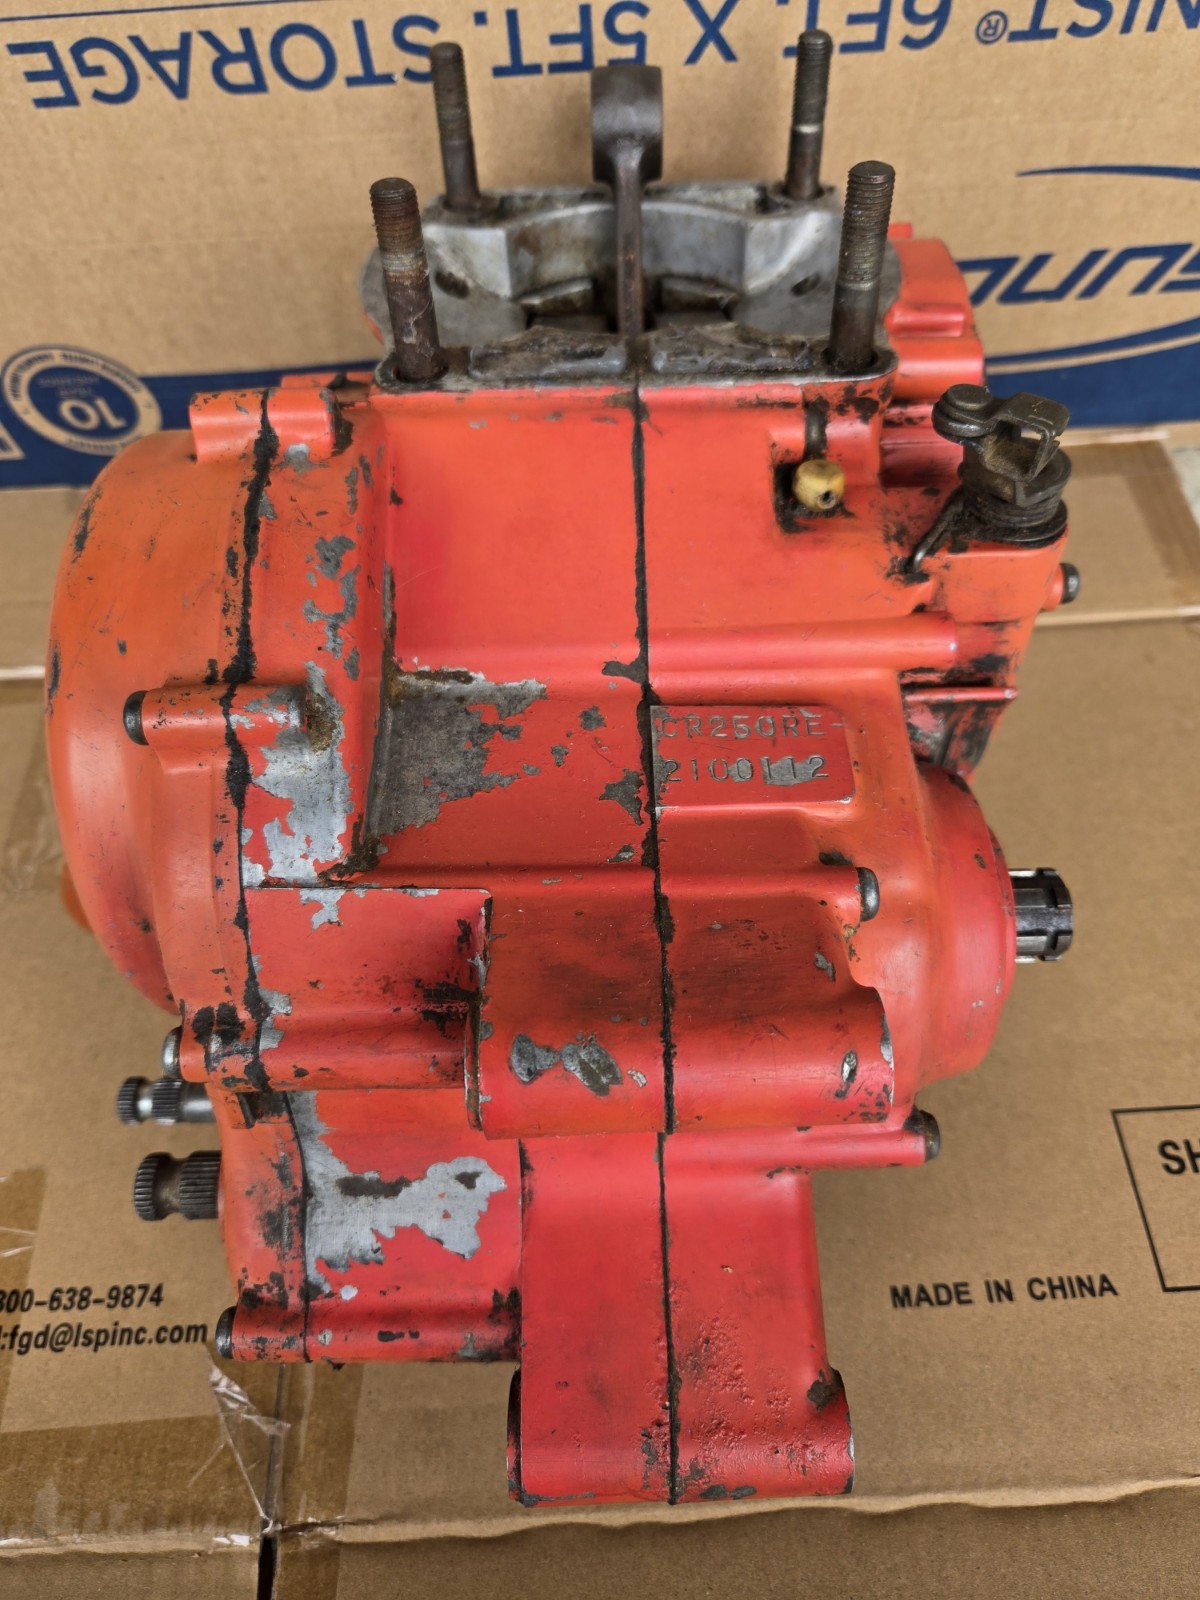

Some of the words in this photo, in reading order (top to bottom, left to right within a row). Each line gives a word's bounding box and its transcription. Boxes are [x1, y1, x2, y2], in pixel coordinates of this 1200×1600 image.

[474, 1, 650, 78] 5FT.
[684, 0, 738, 65] X
[6, 15, 441, 109] STORAGE
[58, 396, 127, 430] 10
[663, 754, 829, 782] 2100112
[889, 1281, 973, 1309] MADE
[984, 1278, 1014, 1304] IN
[1027, 1273, 1119, 1302] CHINA
